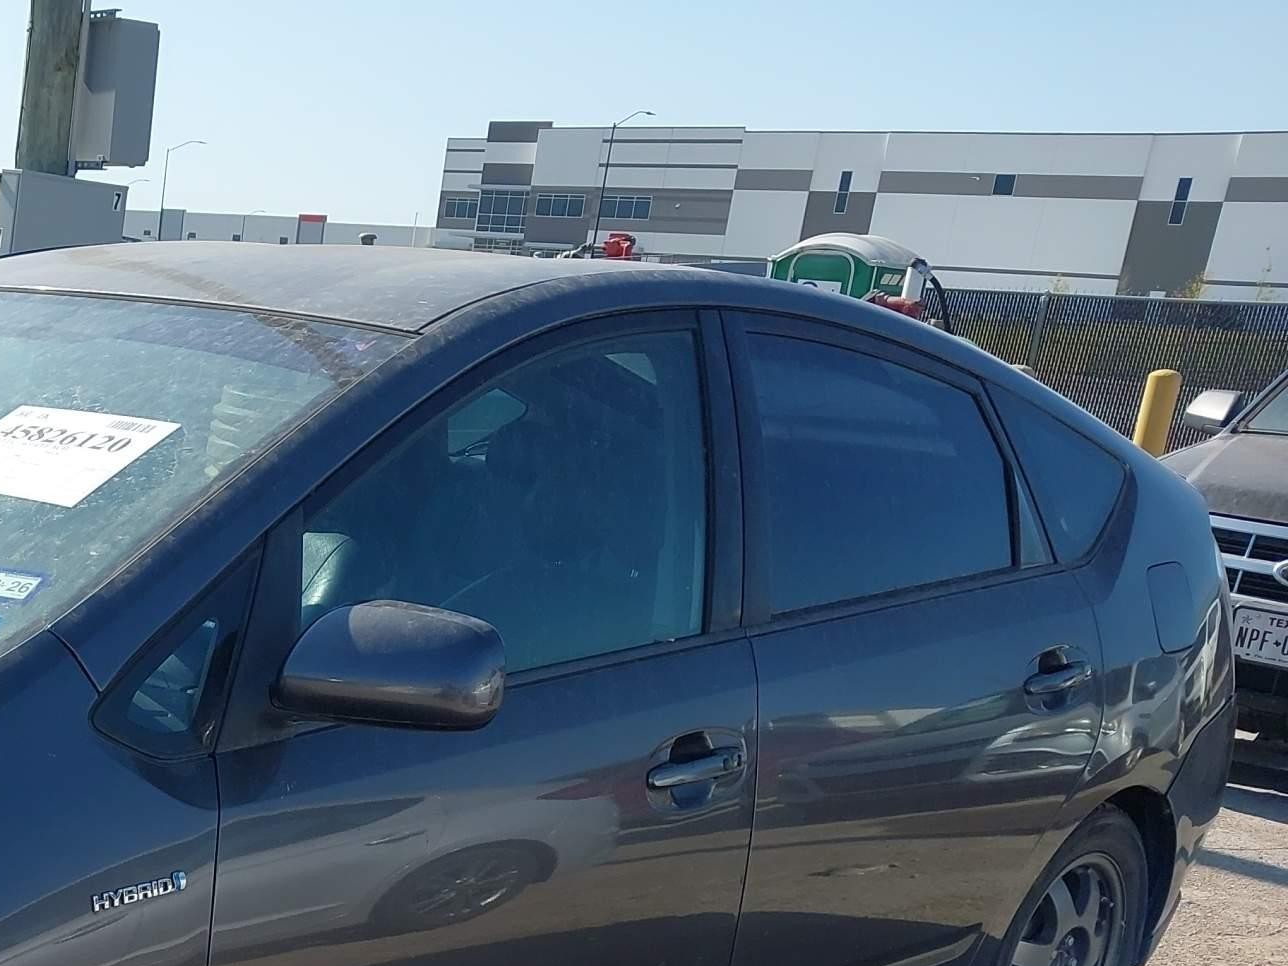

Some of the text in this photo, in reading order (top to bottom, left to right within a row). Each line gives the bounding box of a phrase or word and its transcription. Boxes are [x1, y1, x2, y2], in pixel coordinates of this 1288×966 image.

[114, 192, 122, 211] 7
[0, 424, 132, 452] 45826120
[93, 878, 175, 912] HYBRID
